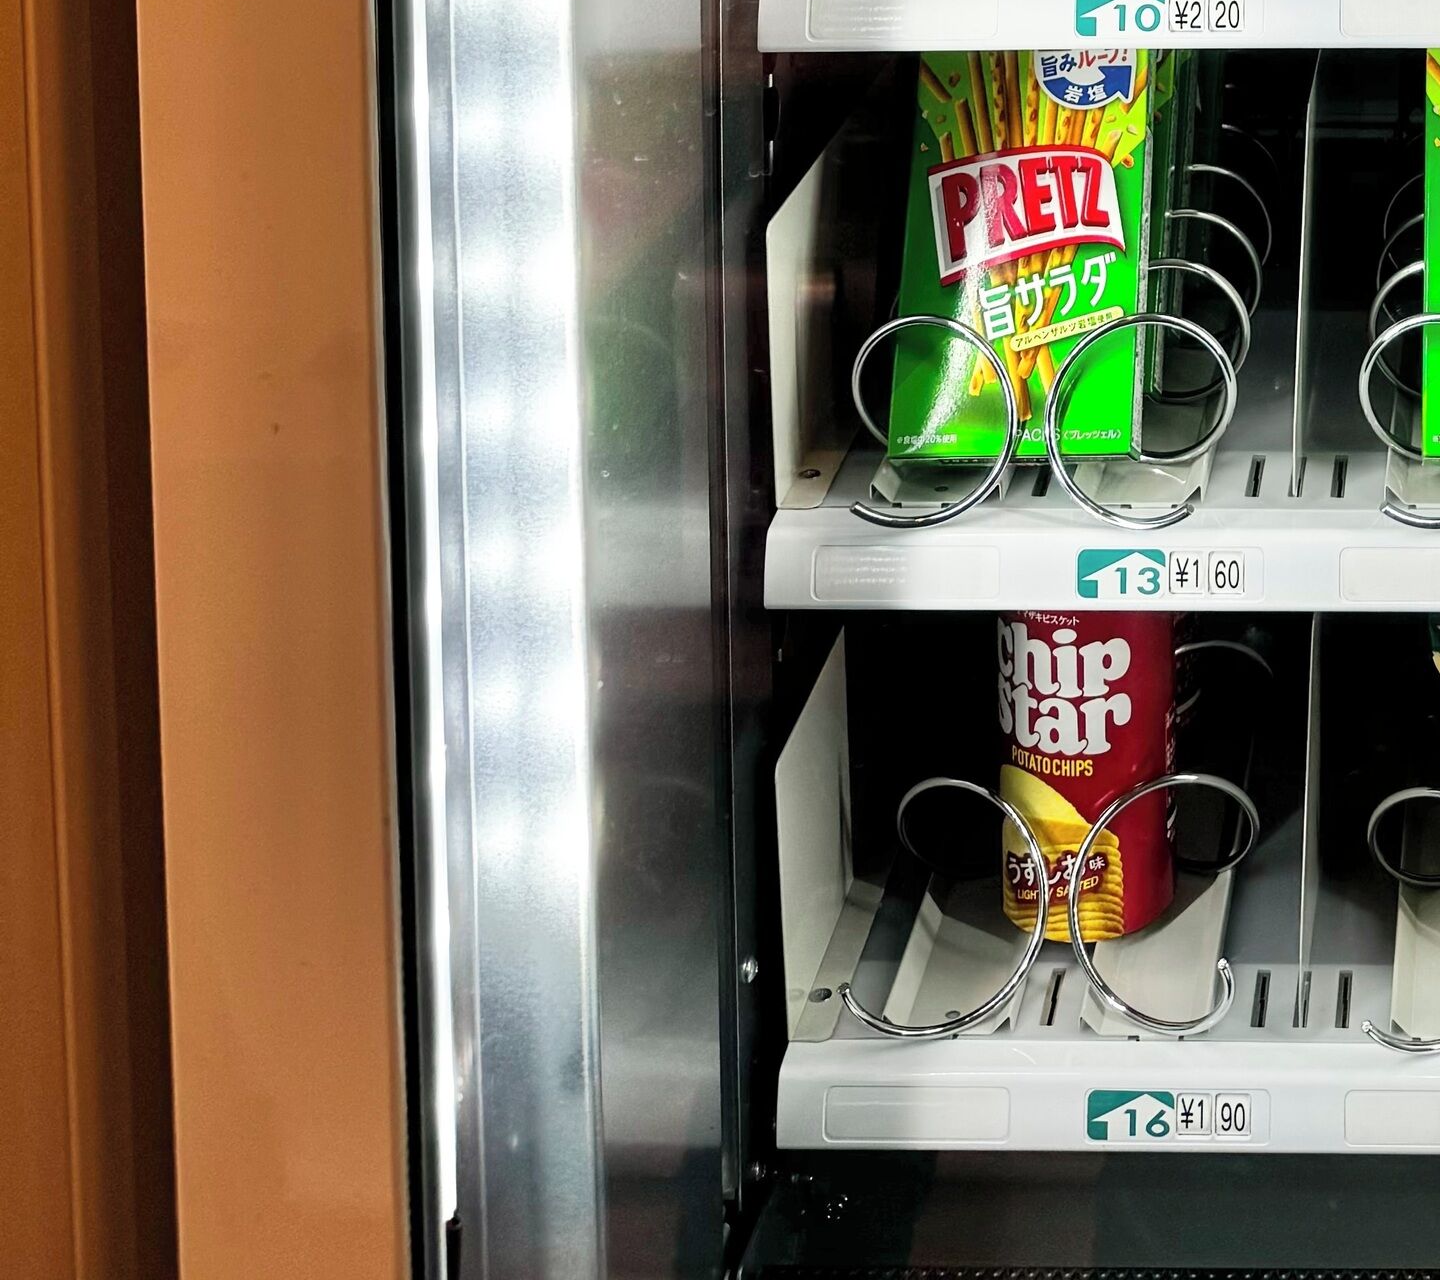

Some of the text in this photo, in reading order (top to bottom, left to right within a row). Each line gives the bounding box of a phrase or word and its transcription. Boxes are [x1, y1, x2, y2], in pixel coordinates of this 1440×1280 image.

[1113, 3, 1162, 33] 10
[1064, 83, 1108, 104] 岩塩
[936, 154, 1112, 264] PRETZ
[977, 253, 1118, 340] 旨サラダ
[1112, 565, 1162, 596] 13
[1011, 744, 1094, 777] POTATO CHIPS
[1123, 1108, 1171, 1139] 16
